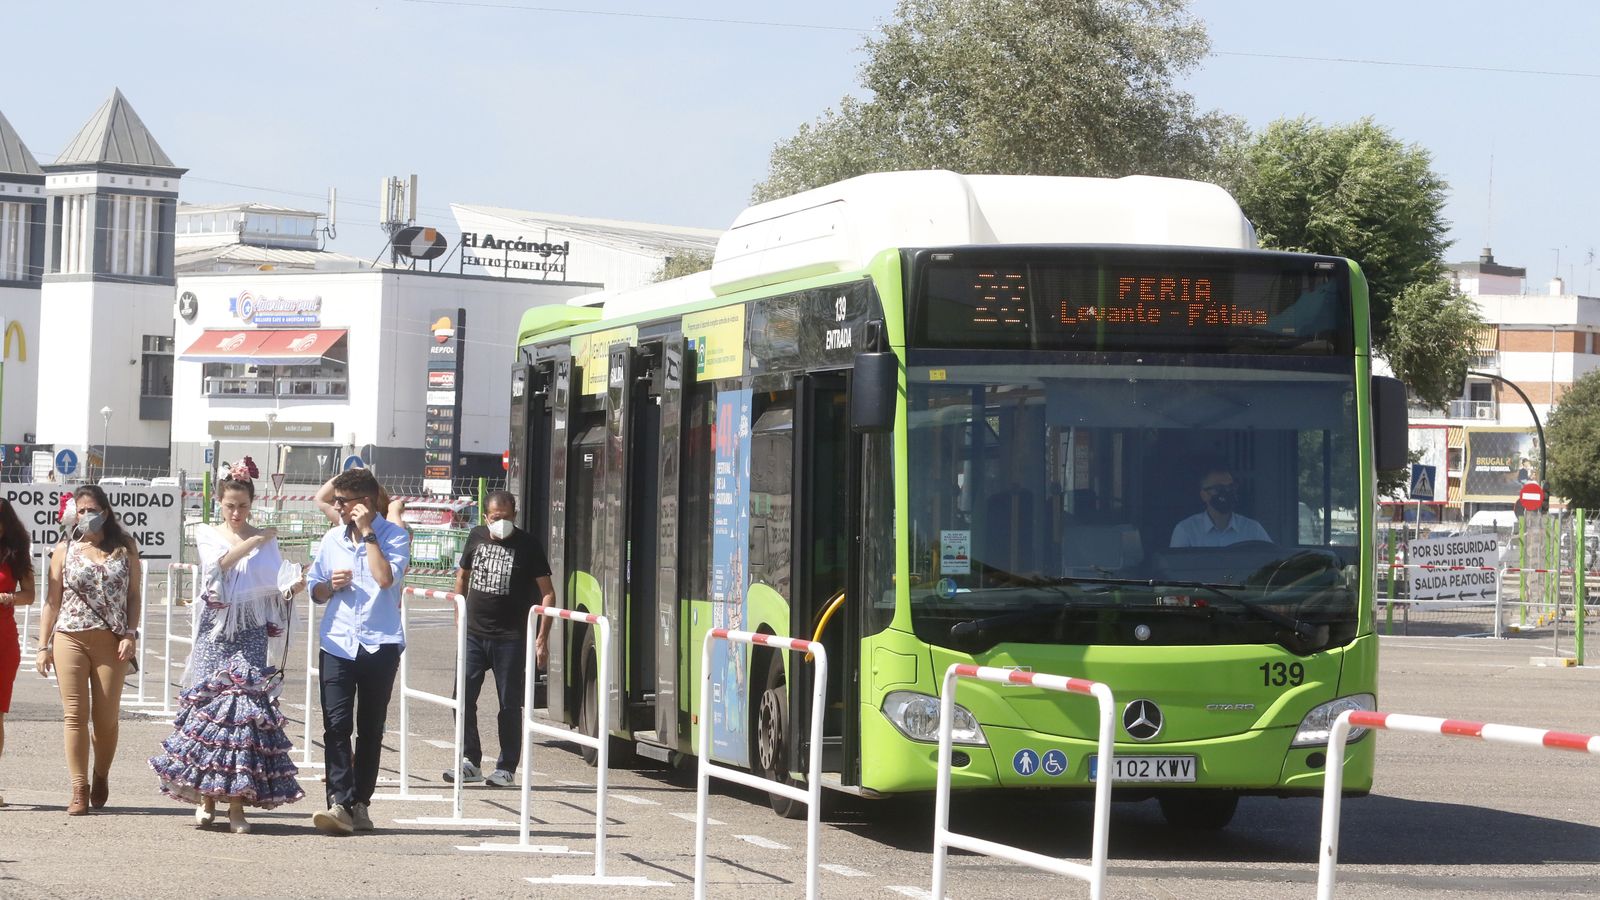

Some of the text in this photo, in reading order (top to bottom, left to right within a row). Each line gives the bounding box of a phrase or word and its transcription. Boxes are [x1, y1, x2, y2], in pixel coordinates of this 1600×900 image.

[462, 232, 570, 257] El Arcángel
[462, 256, 565, 273] CENTRO COMERCIAL
[1119, 277, 1211, 301] FERIA
[835, 296, 847, 322] 139
[1061, 300, 1161, 323] Levante
[1188, 301, 1267, 326] Fátima
[826, 328, 852, 350] ENTRADA
[430, 346, 454, 354] REPSOL
[717, 403, 732, 457] 41
[1476, 457, 1505, 466] BRUGAL
[8, 491, 174, 508] POR S URIDAD
[1412, 540, 1497, 559] POR SU SEGURIDAD
[1465, 556, 1485, 569] POR
[1415, 571, 1496, 591] SALIDA PEATONES
[1259, 661, 1305, 687] 139
[1206, 703, 1256, 712] CITARO
[1111, 759, 1191, 778] 102 KWV
